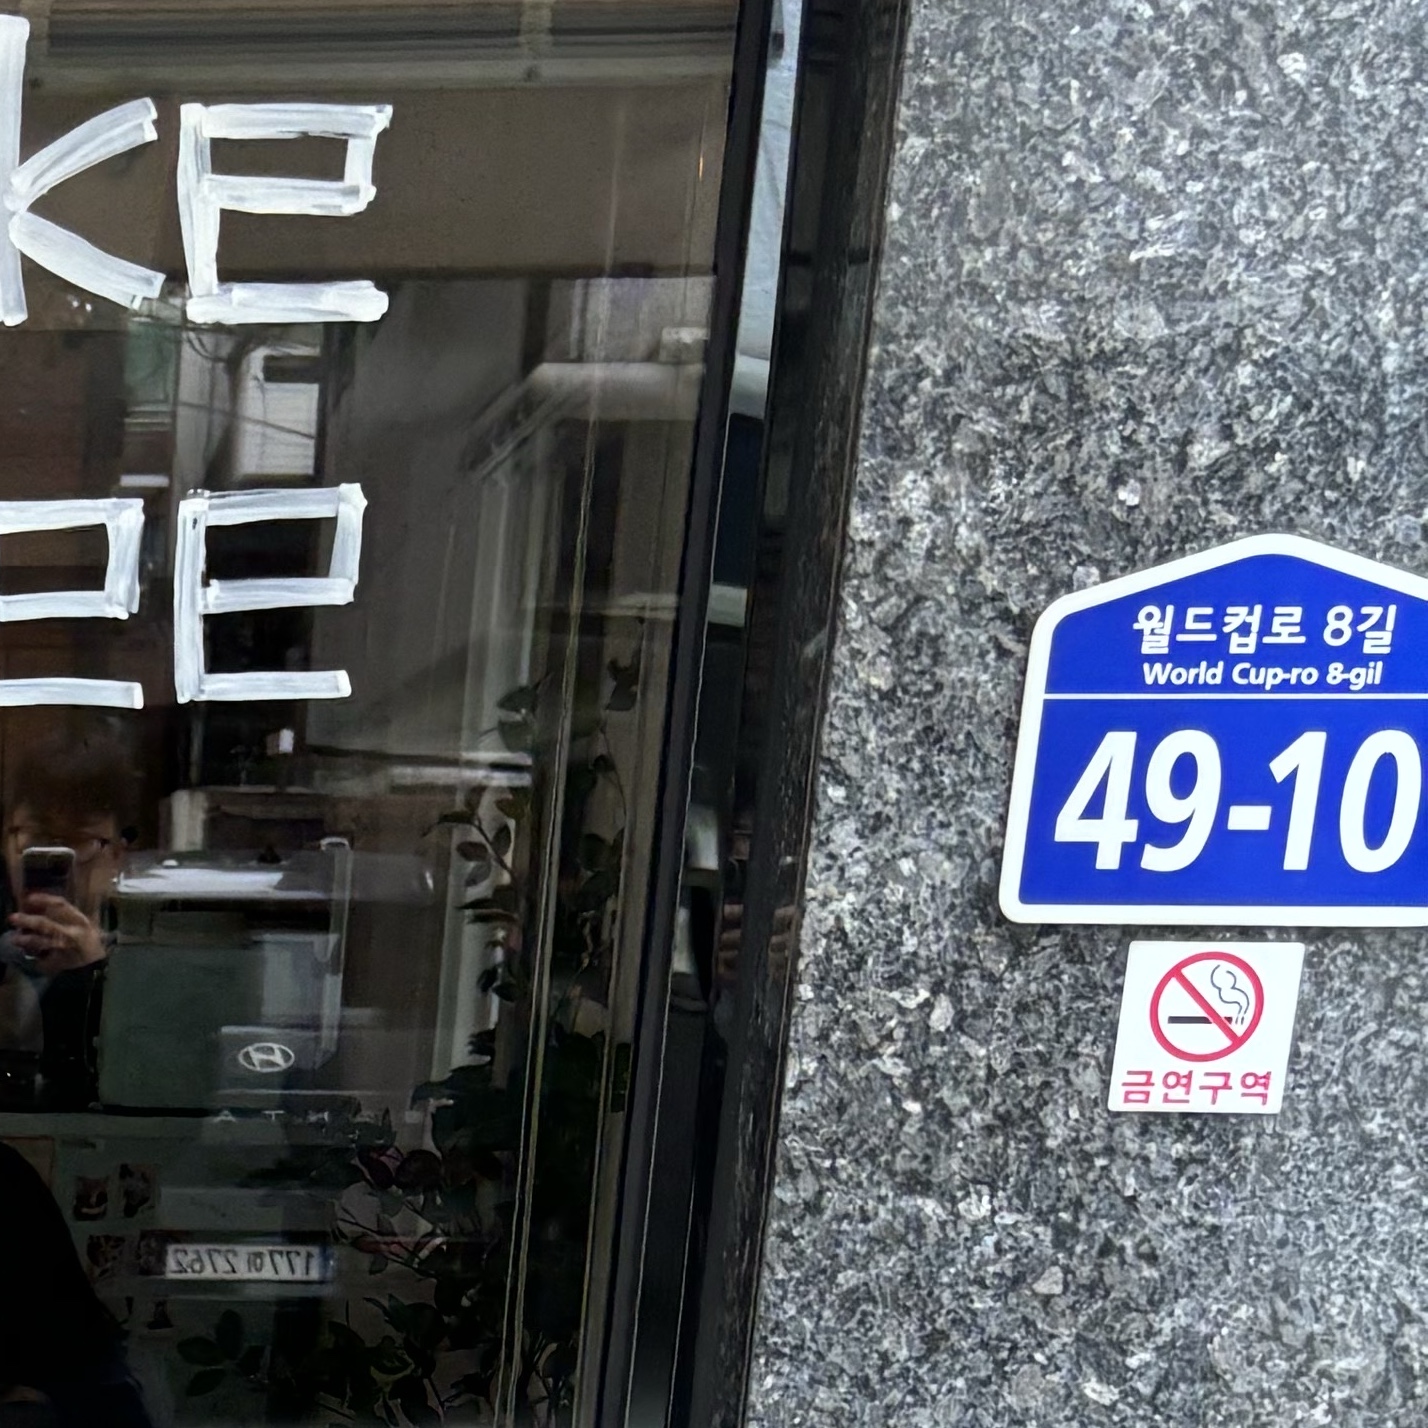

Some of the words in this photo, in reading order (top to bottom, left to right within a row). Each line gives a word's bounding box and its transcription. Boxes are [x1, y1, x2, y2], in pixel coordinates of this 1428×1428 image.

[1133, 605, 1306, 654] 월드컵로
[1323, 605, 1397, 654] 8길
[1143, 661, 1224, 685] World
[1232, 662, 1319, 690] Cup-ro
[1326, 661, 1384, 690] 8-gil
[1054, 729, 1422, 872] 49-10
[1121, 1070, 1273, 1105] 금연구역
